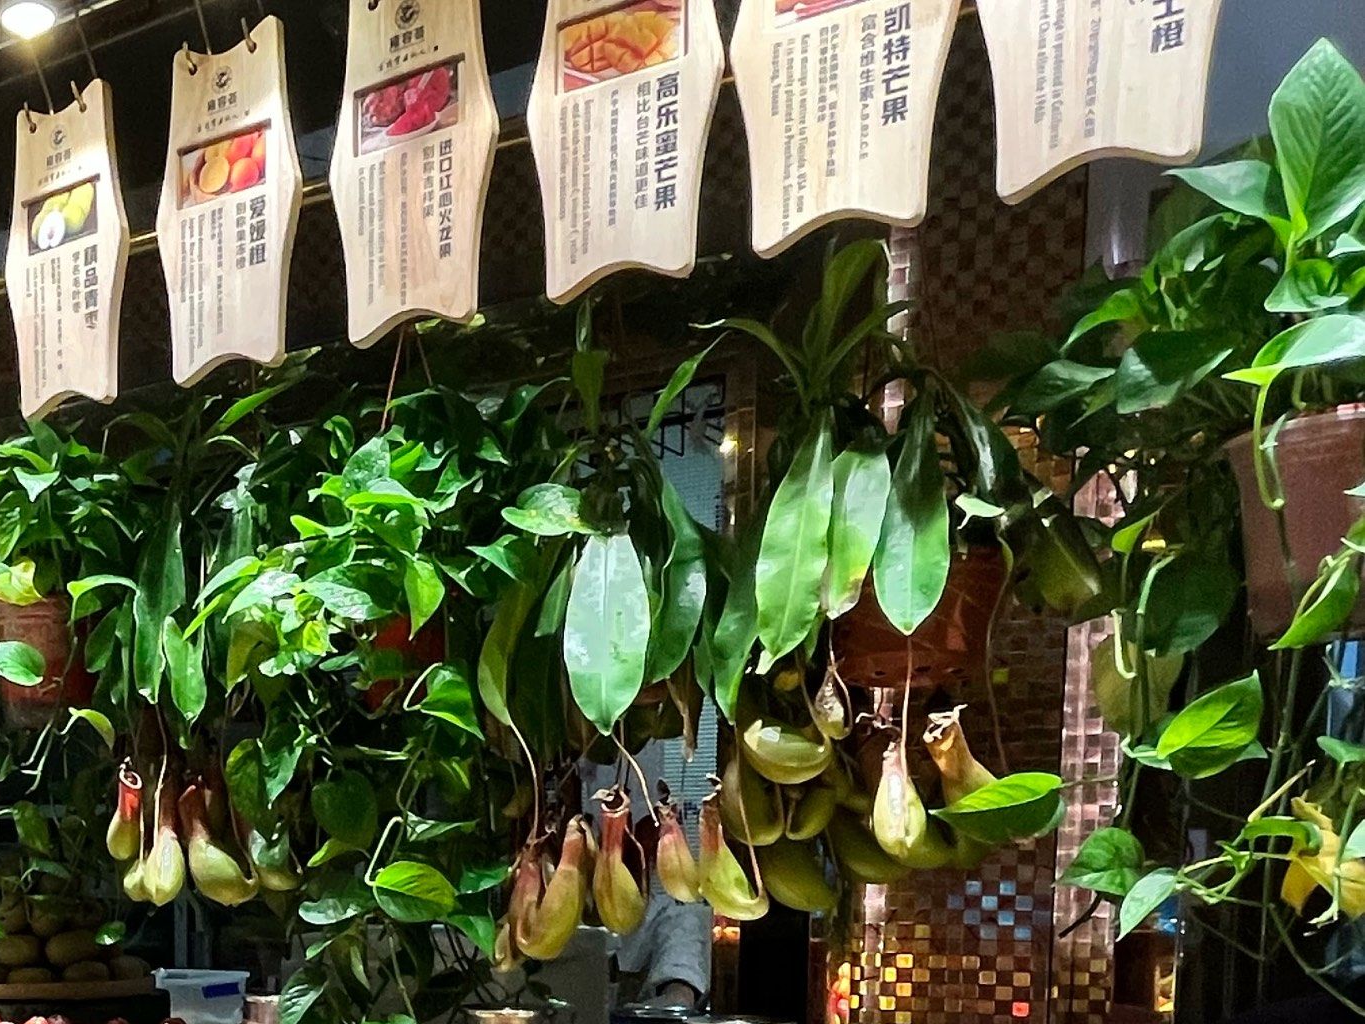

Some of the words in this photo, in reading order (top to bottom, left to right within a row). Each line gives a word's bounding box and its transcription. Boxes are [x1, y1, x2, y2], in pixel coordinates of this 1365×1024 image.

[881, 2, 912, 126] 凯特芒果
[652, 70, 680, 211] 高乐蜜芒果
